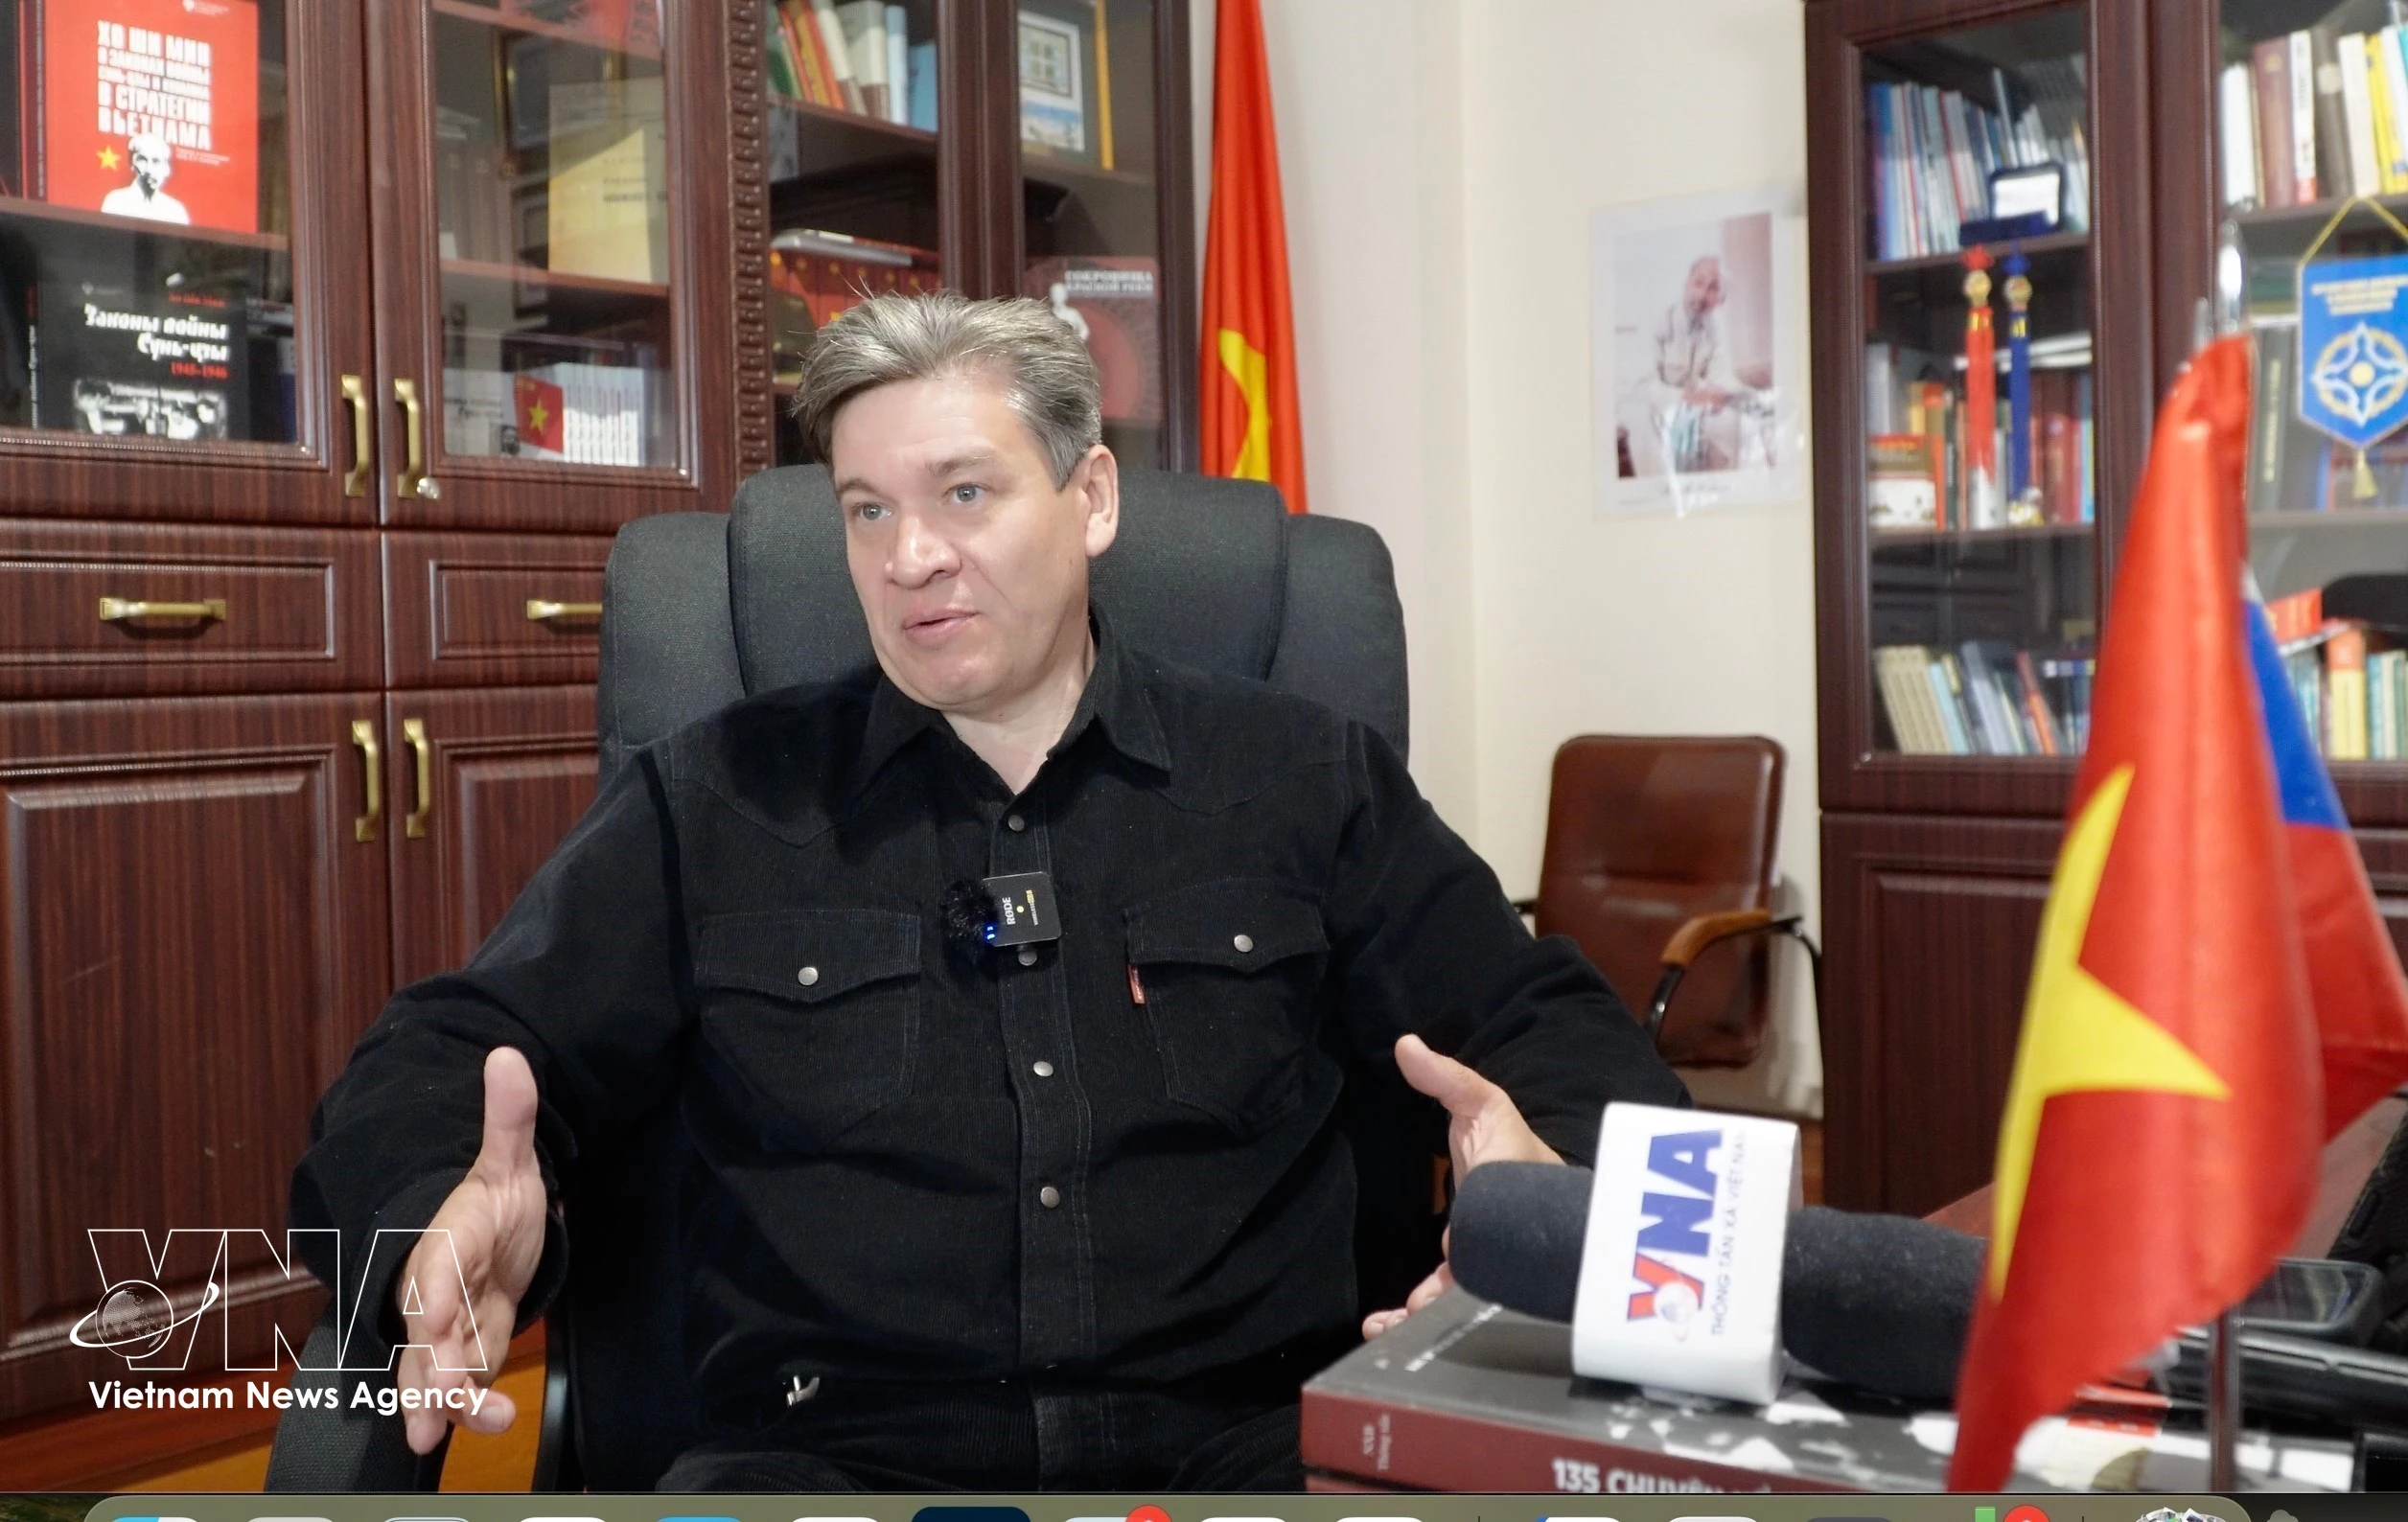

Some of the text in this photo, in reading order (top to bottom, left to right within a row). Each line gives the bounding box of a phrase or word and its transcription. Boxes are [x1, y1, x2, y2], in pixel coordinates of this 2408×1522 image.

[97, 19, 210, 68] ХО ШИ МИН
[97, 105, 211, 151] ВЬЕТНАМА
[83, 302, 230, 340] Законы войны
[136, 332, 230, 363] Сунь-цзы
[1627, 1129, 1723, 1321] VNA
[1710, 1274, 1732, 1337] THÔNG
[1551, 1457, 1725, 1493] 135 CHU
